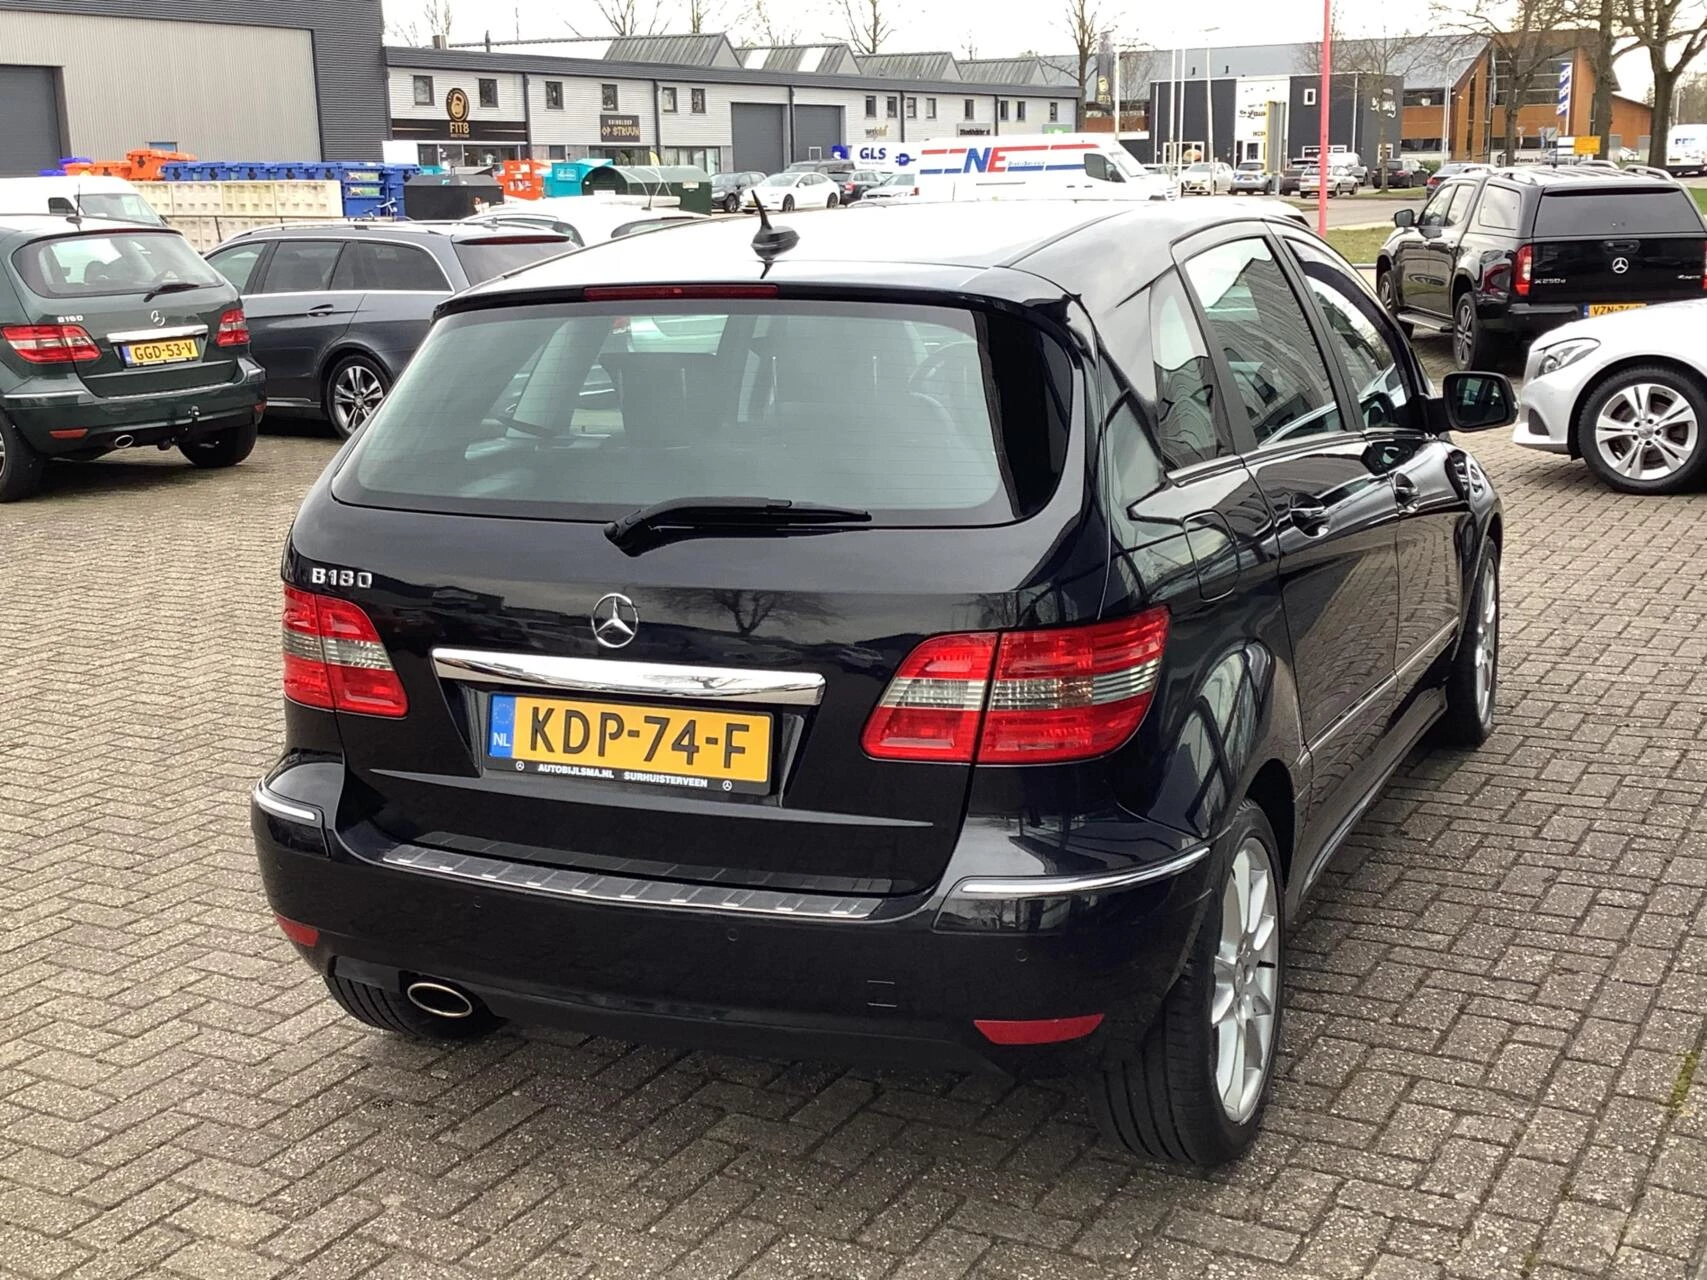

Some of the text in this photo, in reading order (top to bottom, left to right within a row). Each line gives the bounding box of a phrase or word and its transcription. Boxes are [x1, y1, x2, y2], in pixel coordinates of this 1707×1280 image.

[449, 122, 470, 134] FIT8
[859, 147, 887, 160] GLS
[963, 146, 1006, 173] NE
[134, 341, 194, 361] GGD-53-V
[311, 567, 373, 589] B180
[493, 732, 511, 747] NL
[529, 706, 750, 769] KDP-74-F
[537, 763, 708, 788] AUTOBIJLSMA.NL SURHUISTERVEEN
